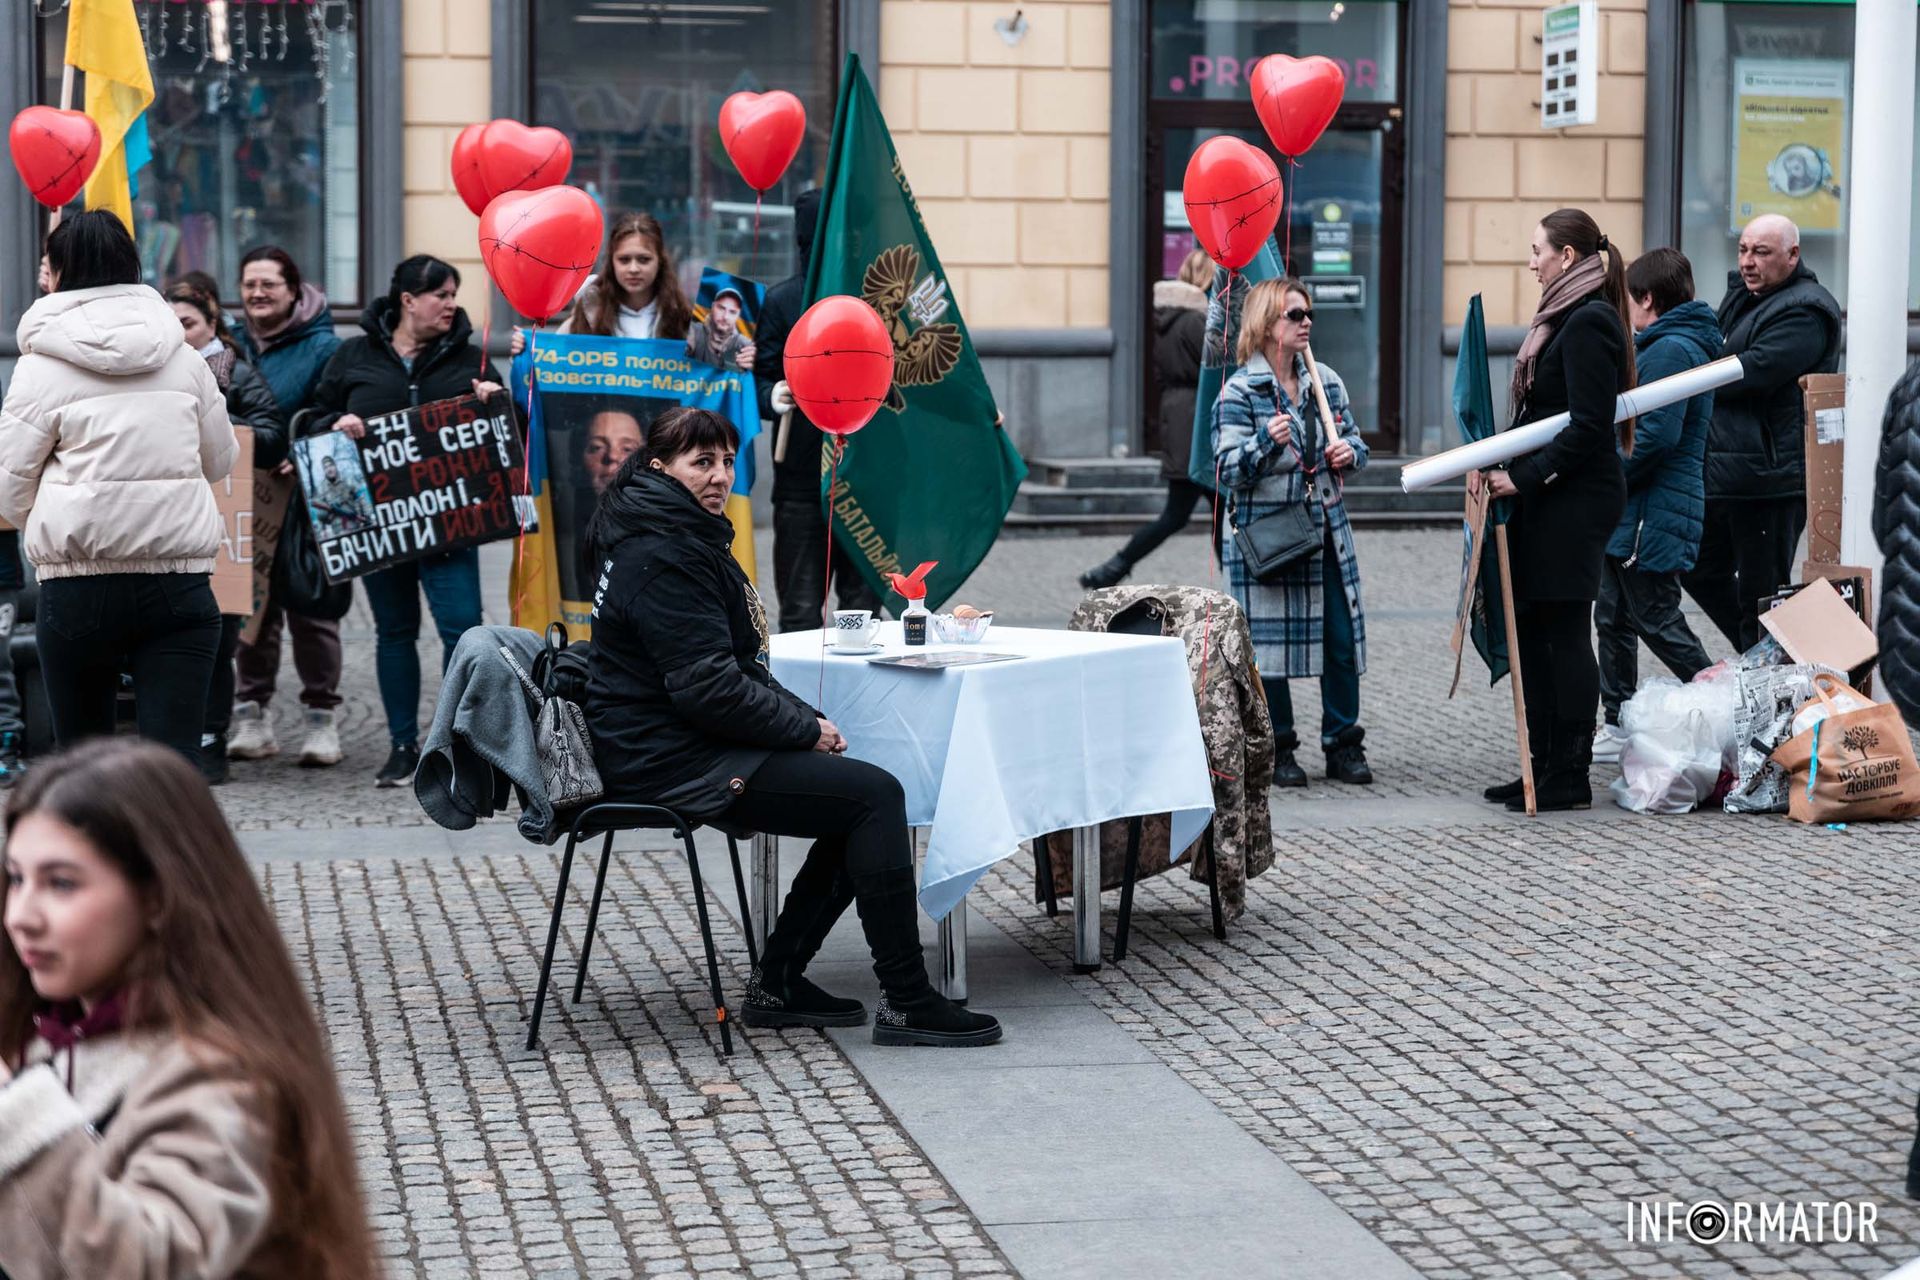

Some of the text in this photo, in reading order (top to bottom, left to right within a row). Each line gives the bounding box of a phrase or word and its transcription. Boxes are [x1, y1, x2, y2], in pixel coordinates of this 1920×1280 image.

[626, 355, 692, 374] полон
[363, 414, 512, 473] МОЄ СЕРЦЕ
[320, 517, 437, 577] БАЧИТИ
[833, 495, 906, 588] БАТАЛЬЙО
[1837, 758, 1901, 783] НАС ТОРБУЄ
[1845, 773, 1898, 795] ДОВКІЛЛЯ
